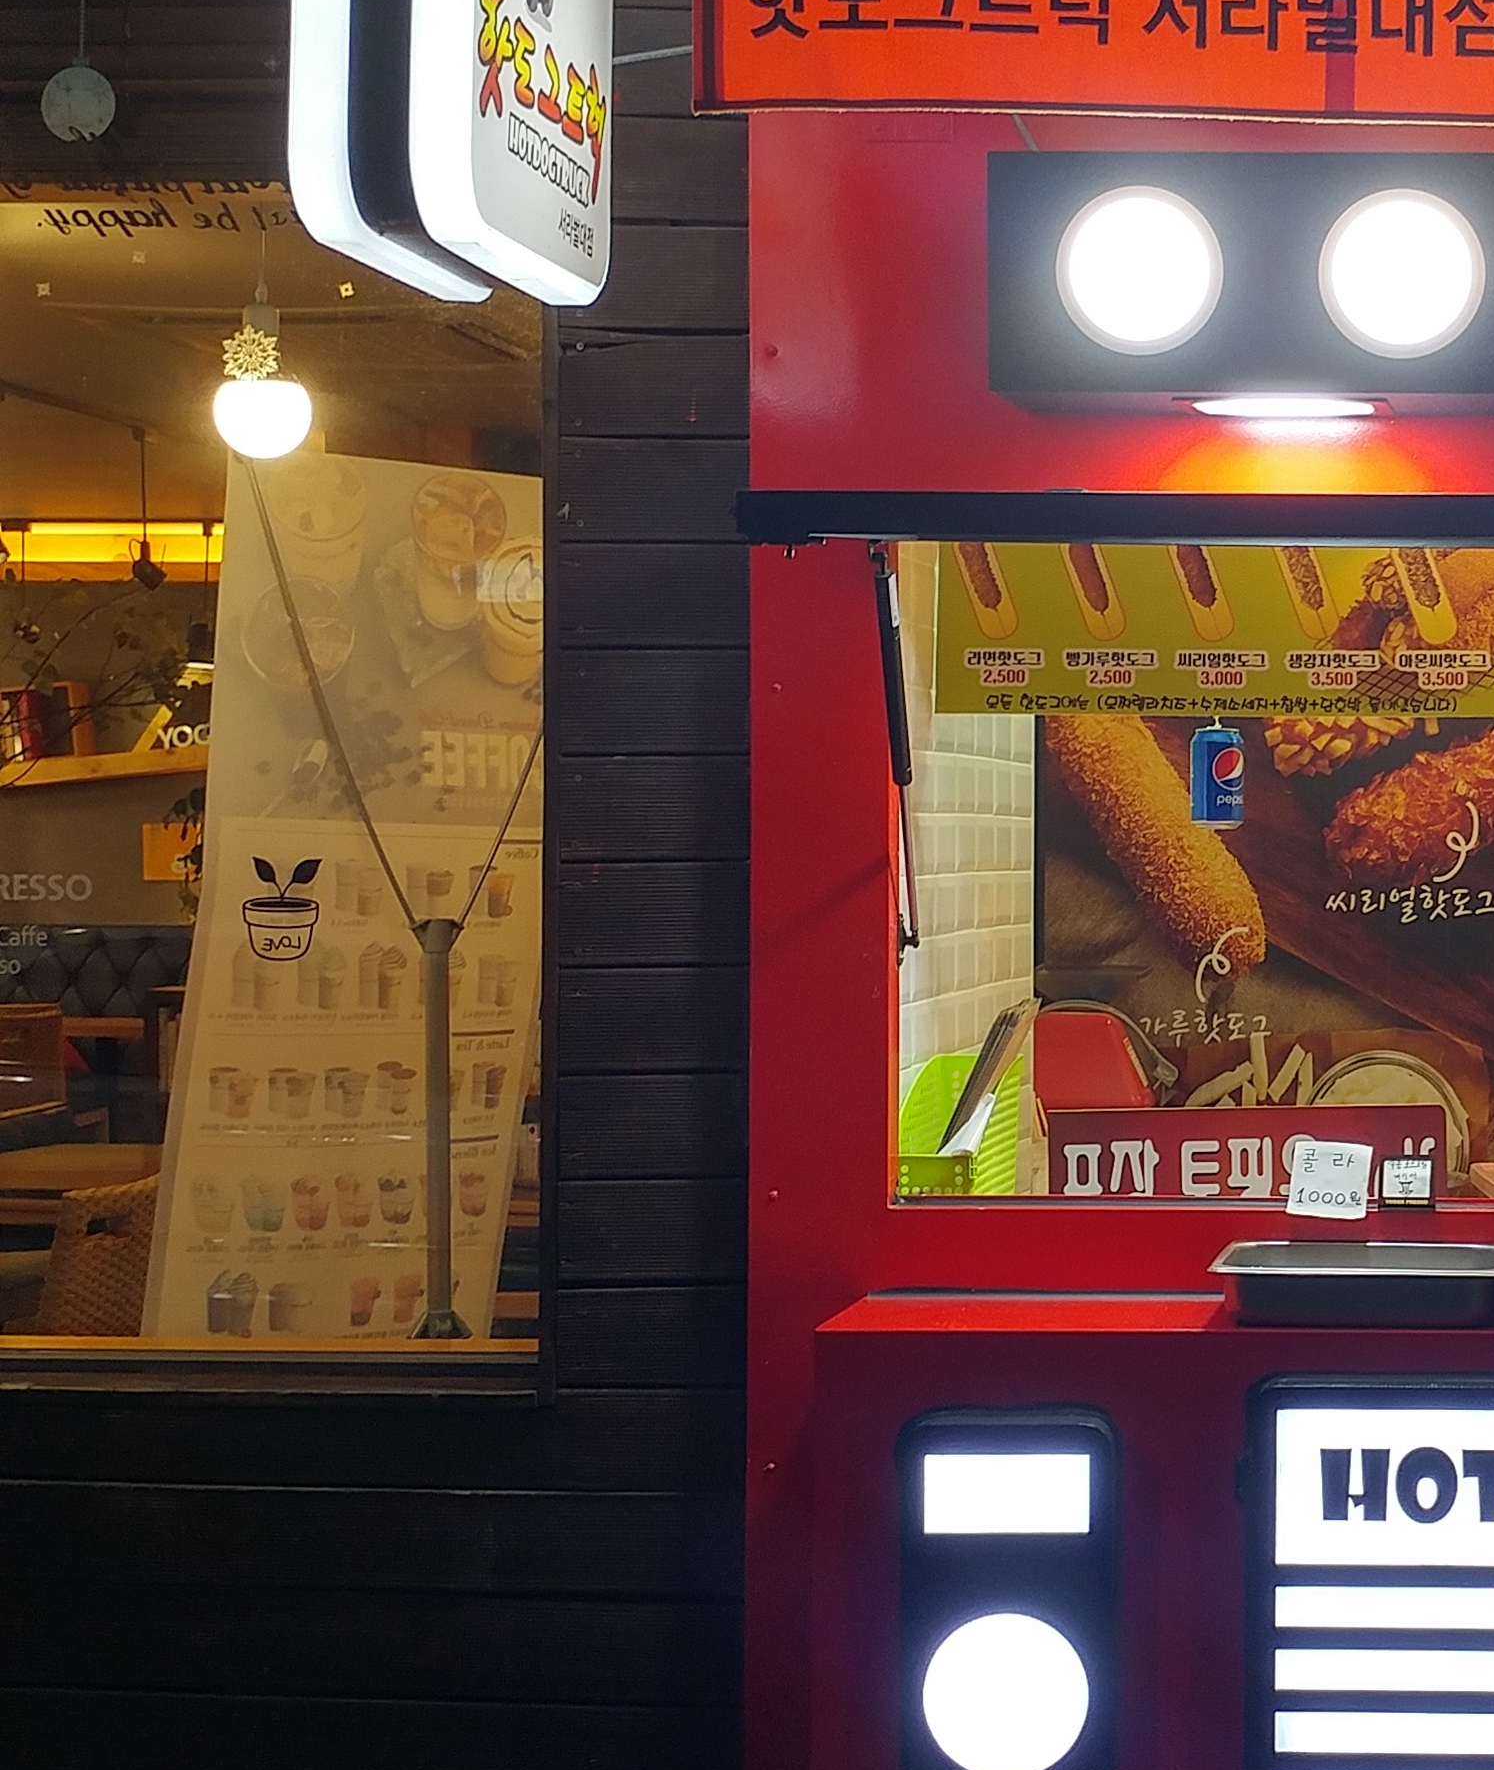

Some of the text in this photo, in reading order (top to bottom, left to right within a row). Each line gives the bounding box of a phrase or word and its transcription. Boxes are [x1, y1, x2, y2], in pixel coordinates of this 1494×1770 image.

[507, 111, 592, 209] HOTDOGTRUCK
[966, 650, 1042, 667] 라면핫도그
[1065, 651, 1156, 668] 빵가루핫도그
[1176, 652, 1266, 669] 씨리얼핫도그
[1287, 653, 1378, 669] 생감자핫도그
[982, 669, 1026, 685] 2,500
[1088, 670, 1132, 686] 2,500
[1200, 671, 1243, 687] 3,000
[1216, 794, 1244, 807] peps
[1295, 1186, 1363, 1207] 1000원
